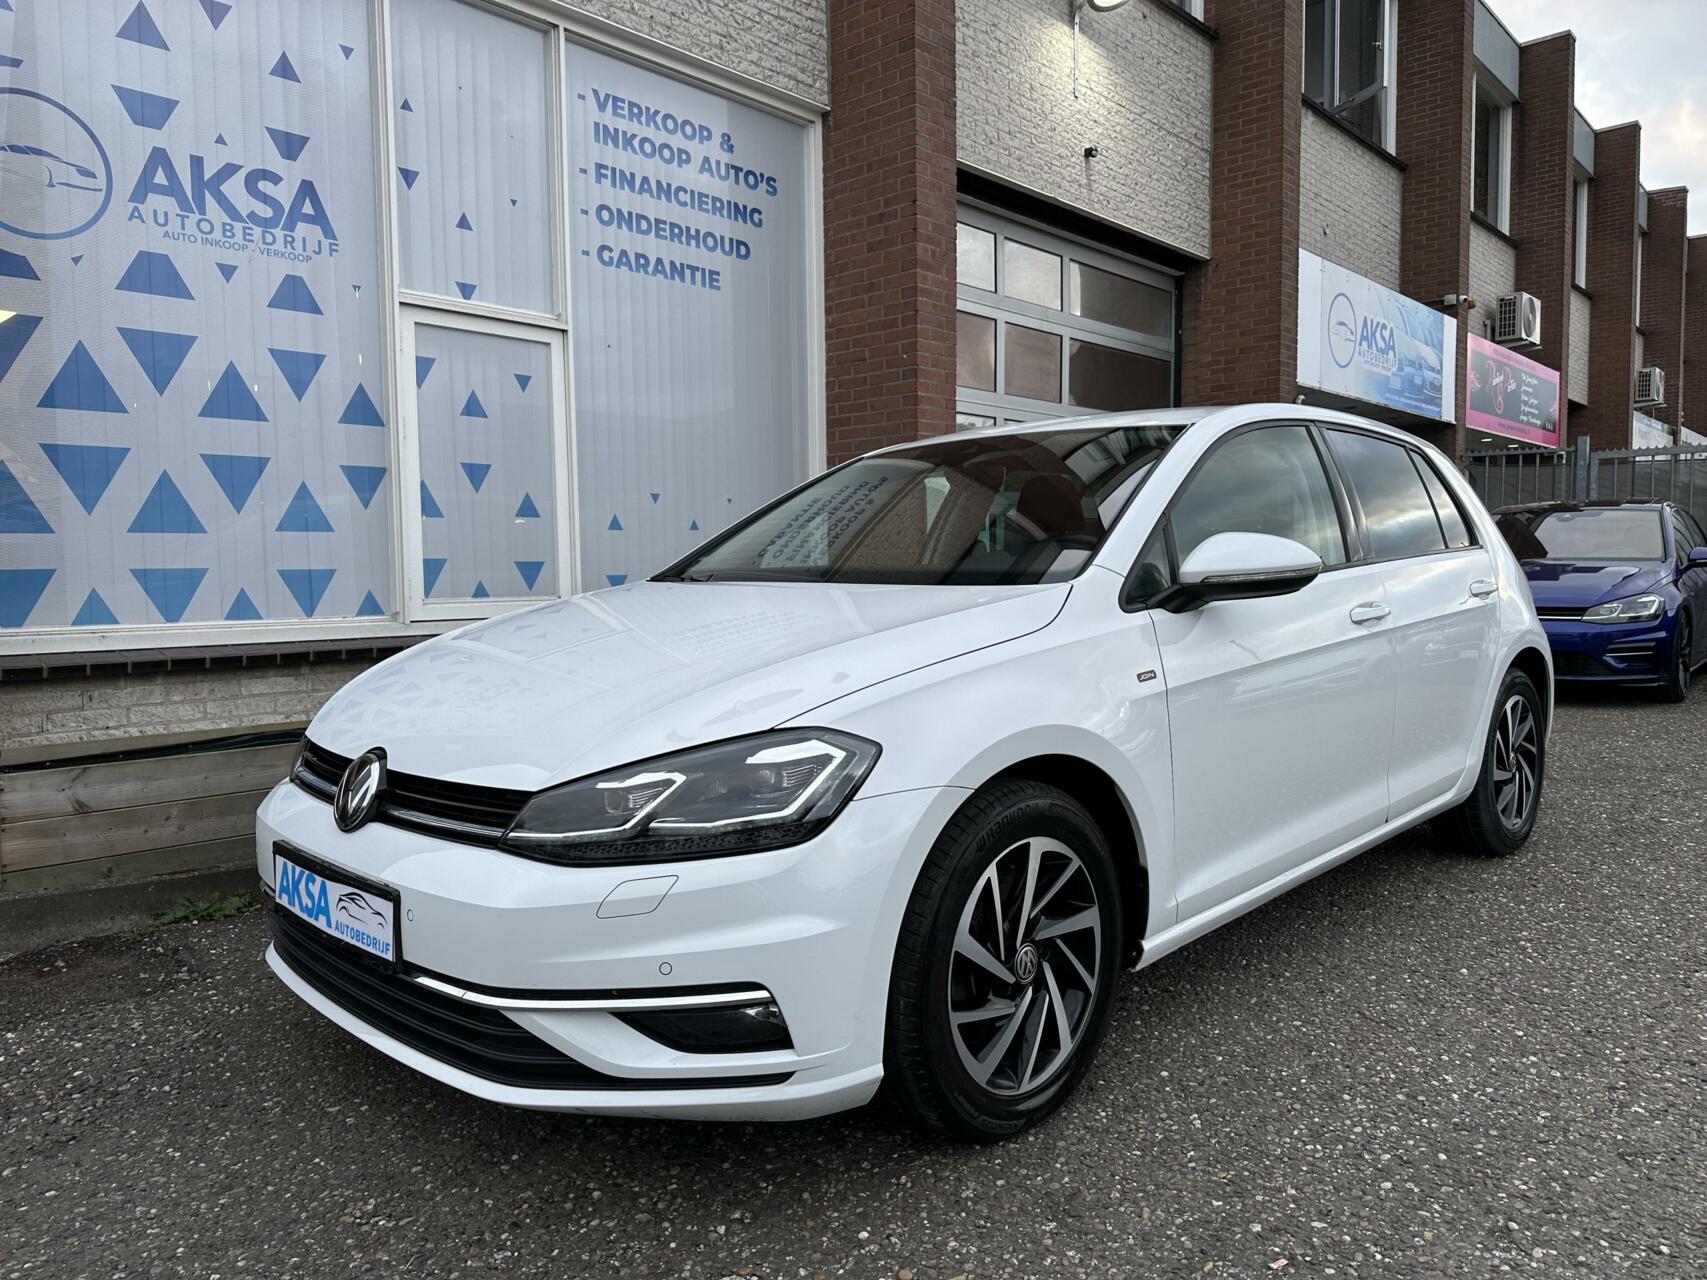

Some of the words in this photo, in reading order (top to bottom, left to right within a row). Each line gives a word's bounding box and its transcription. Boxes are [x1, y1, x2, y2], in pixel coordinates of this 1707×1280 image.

[591, 88, 713, 145] VERKOOP
[719, 132, 735, 154] &
[593, 121, 692, 168] INKOOP
[698, 155, 778, 196] AUTO'S
[128, 145, 338, 241] AKSA
[594, 162, 763, 228] FINANCIERING
[128, 205, 339, 257] AUTOBEDRIJF
[162, 230, 198, 244] AUTO
[201, 236, 249, 252] INKOOP
[258, 246, 312, 263] VERKOOP
[595, 203, 751, 260] ONDERHOUD
[596, 244, 721, 291] GARANTIE
[1358, 315, 1397, 359] AKSA
[278, 860, 332, 929] AKSA
[334, 919, 391, 955] AUTOBEDRIJF
